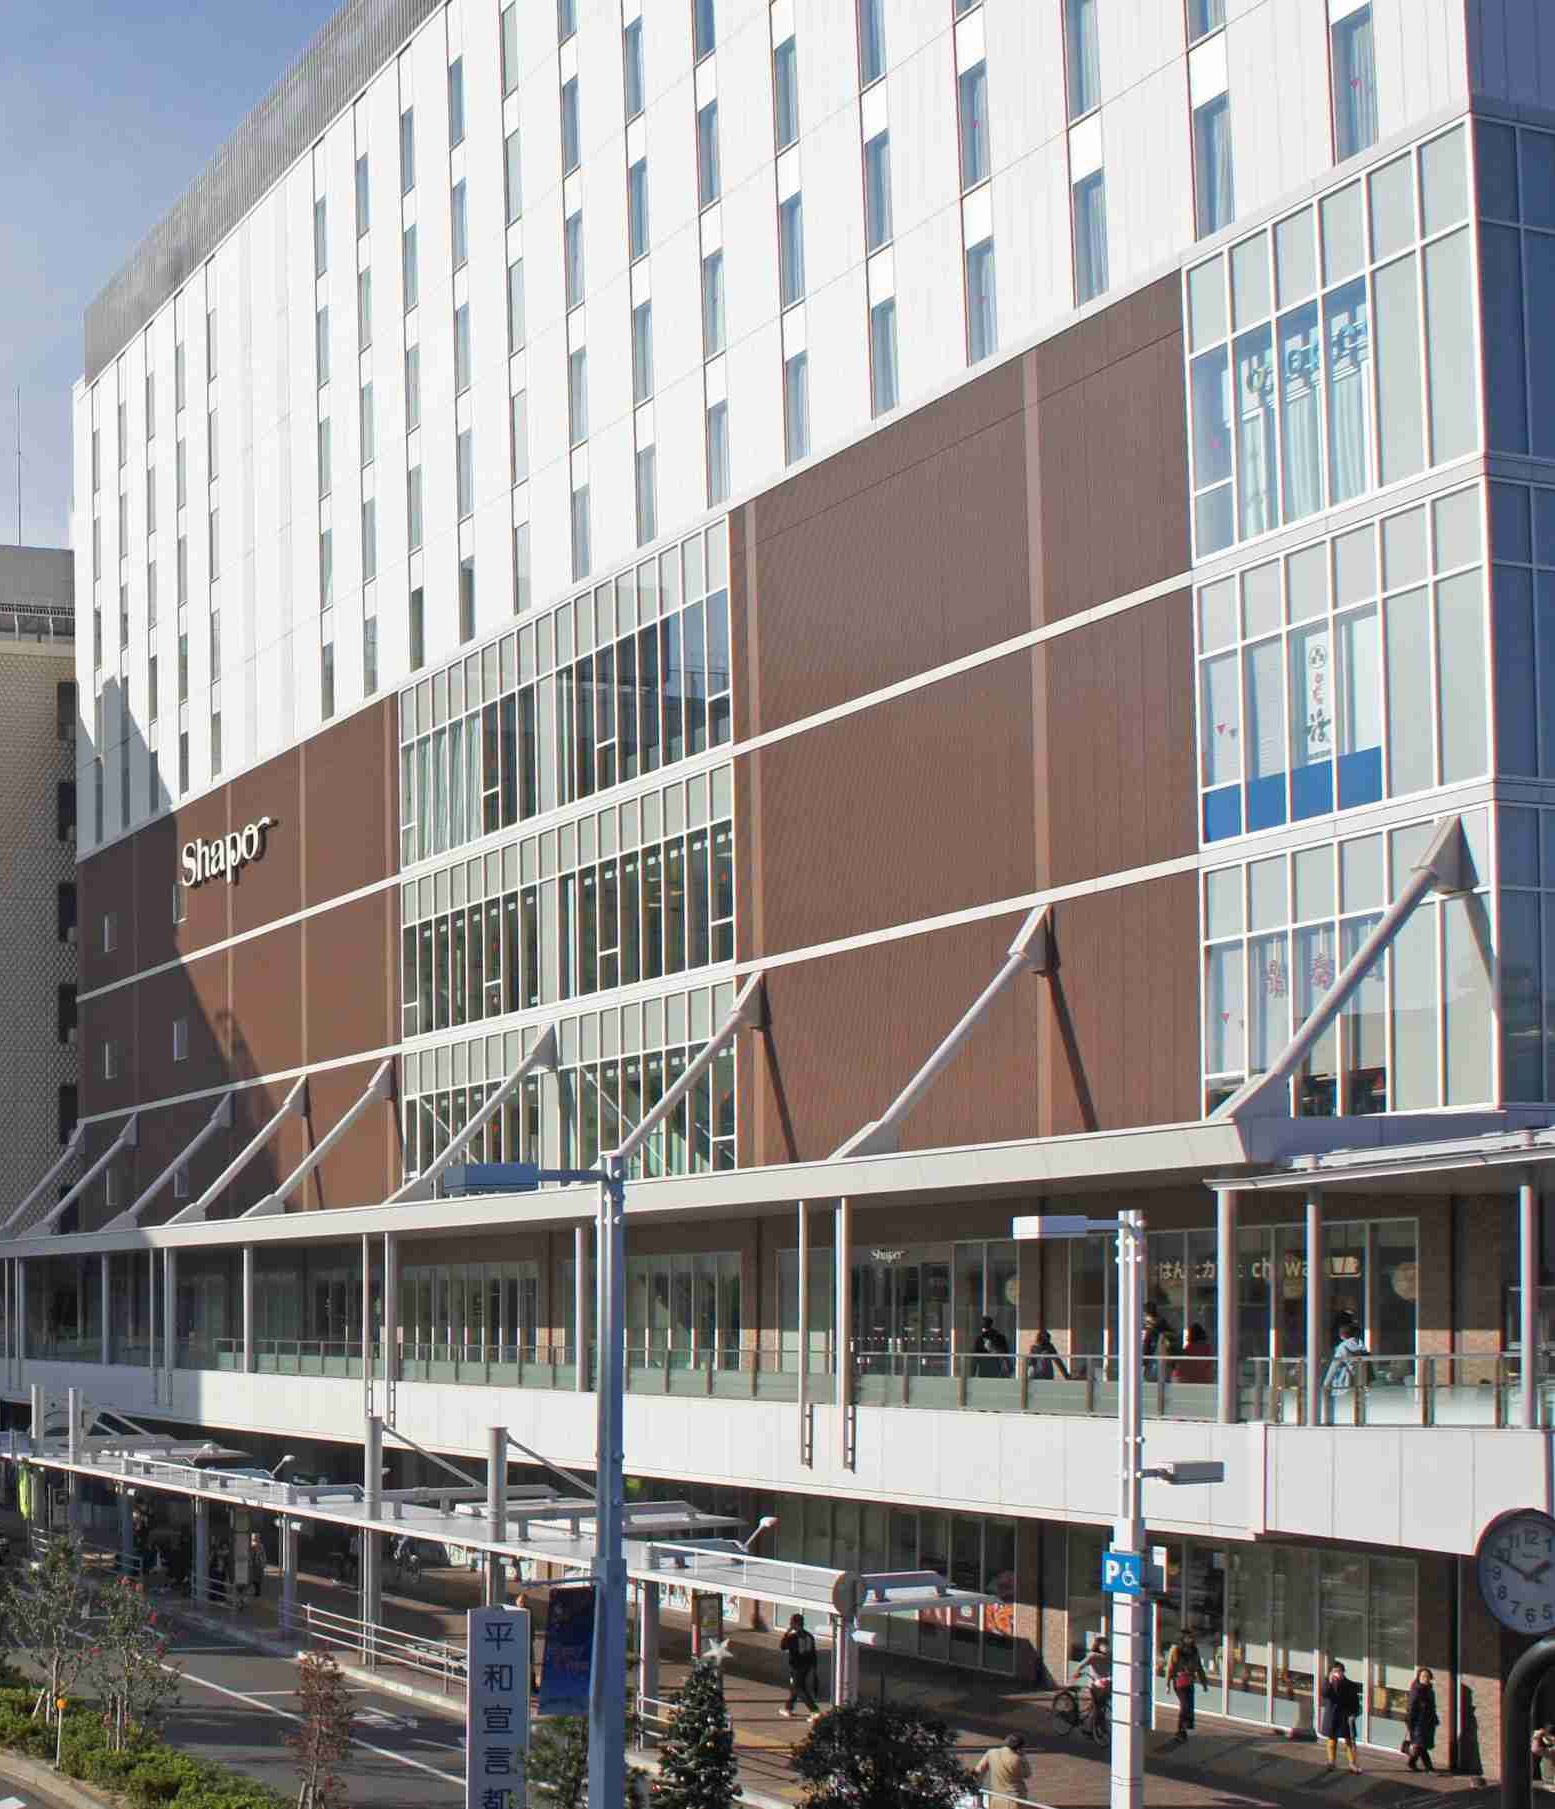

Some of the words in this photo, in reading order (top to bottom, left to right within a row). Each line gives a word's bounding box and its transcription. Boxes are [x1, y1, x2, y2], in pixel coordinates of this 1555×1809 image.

[181, 815, 270, 887] Shapo
[1509, 1534, 1519, 1548] 11
[1525, 1528, 1540, 1544] 12
[1105, 1560, 1119, 1584] P
[1492, 1566, 1502, 1580] 9
[1497, 1586, 1508, 1600] 8
[1510, 1600, 1521, 1615] 7
[1541, 1604, 1552, 1620] 5
[1525, 1608, 1536, 1623] 6
